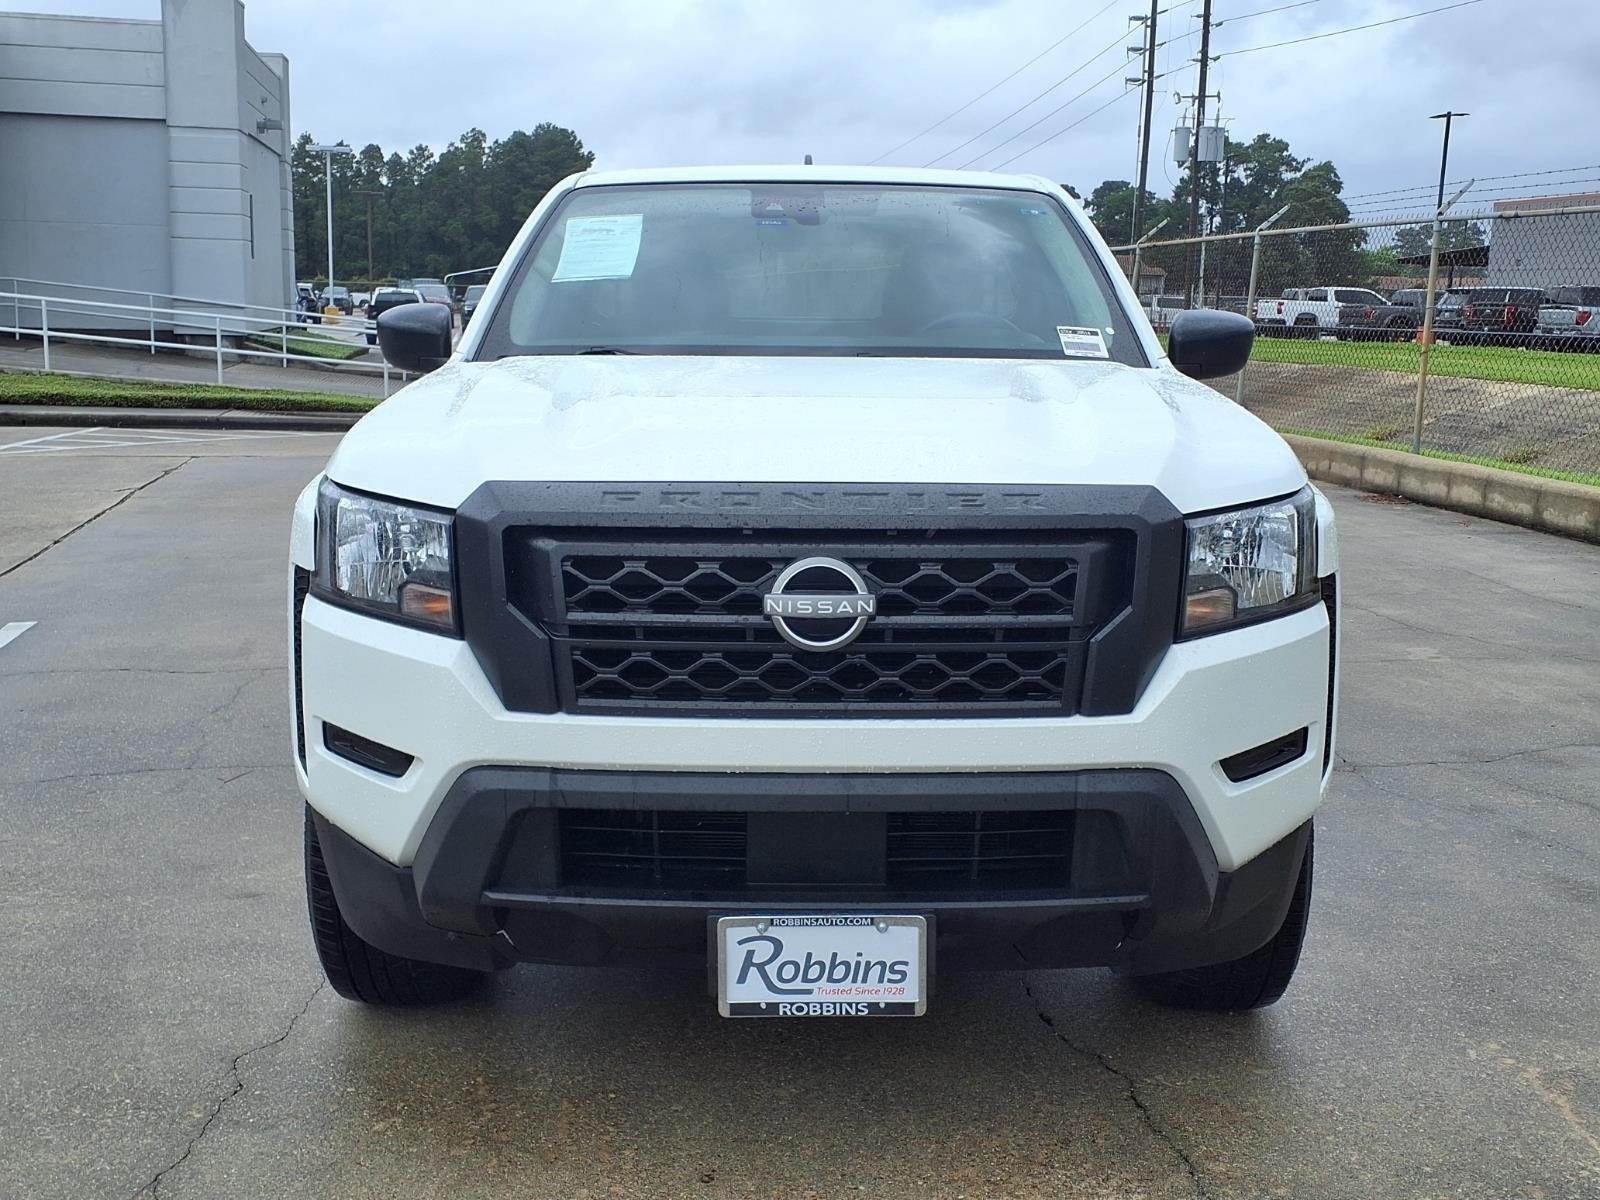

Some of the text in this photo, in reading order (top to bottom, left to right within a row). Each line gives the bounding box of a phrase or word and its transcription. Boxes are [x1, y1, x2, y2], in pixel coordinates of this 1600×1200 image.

[600, 490, 1047, 510] FRONTIER
[766, 599, 874, 614] NISSAN
[773, 917, 871, 927] ROBBINSAUTO.COM
[735, 935, 910, 996] Robbins
[816, 987, 905, 995] Trusted Since 1928
[778, 1002, 869, 1016] ROBBINS
